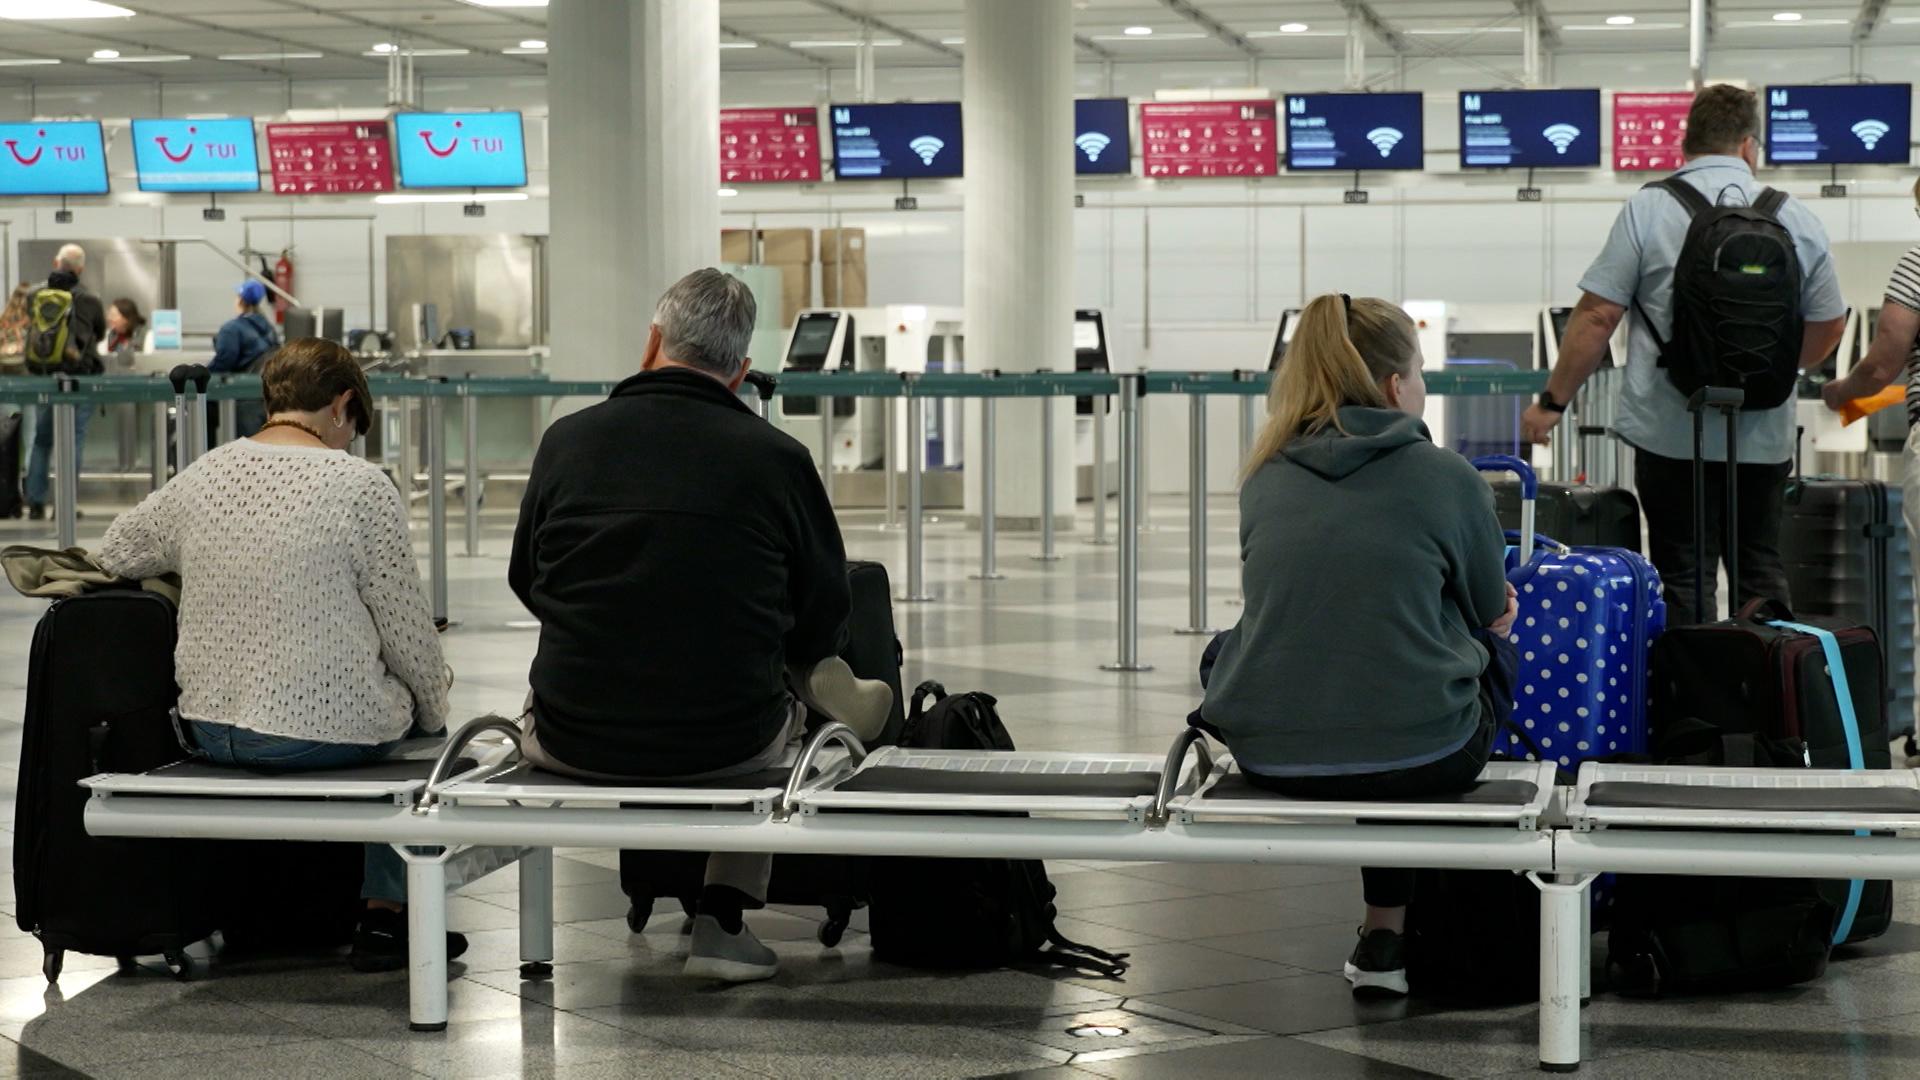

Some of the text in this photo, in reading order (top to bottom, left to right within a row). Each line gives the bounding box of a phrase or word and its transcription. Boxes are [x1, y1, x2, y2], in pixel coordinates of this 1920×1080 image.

[205, 143, 236, 158] TUI
[471, 138, 503, 153] TUI
[54, 146, 85, 162] TUI
